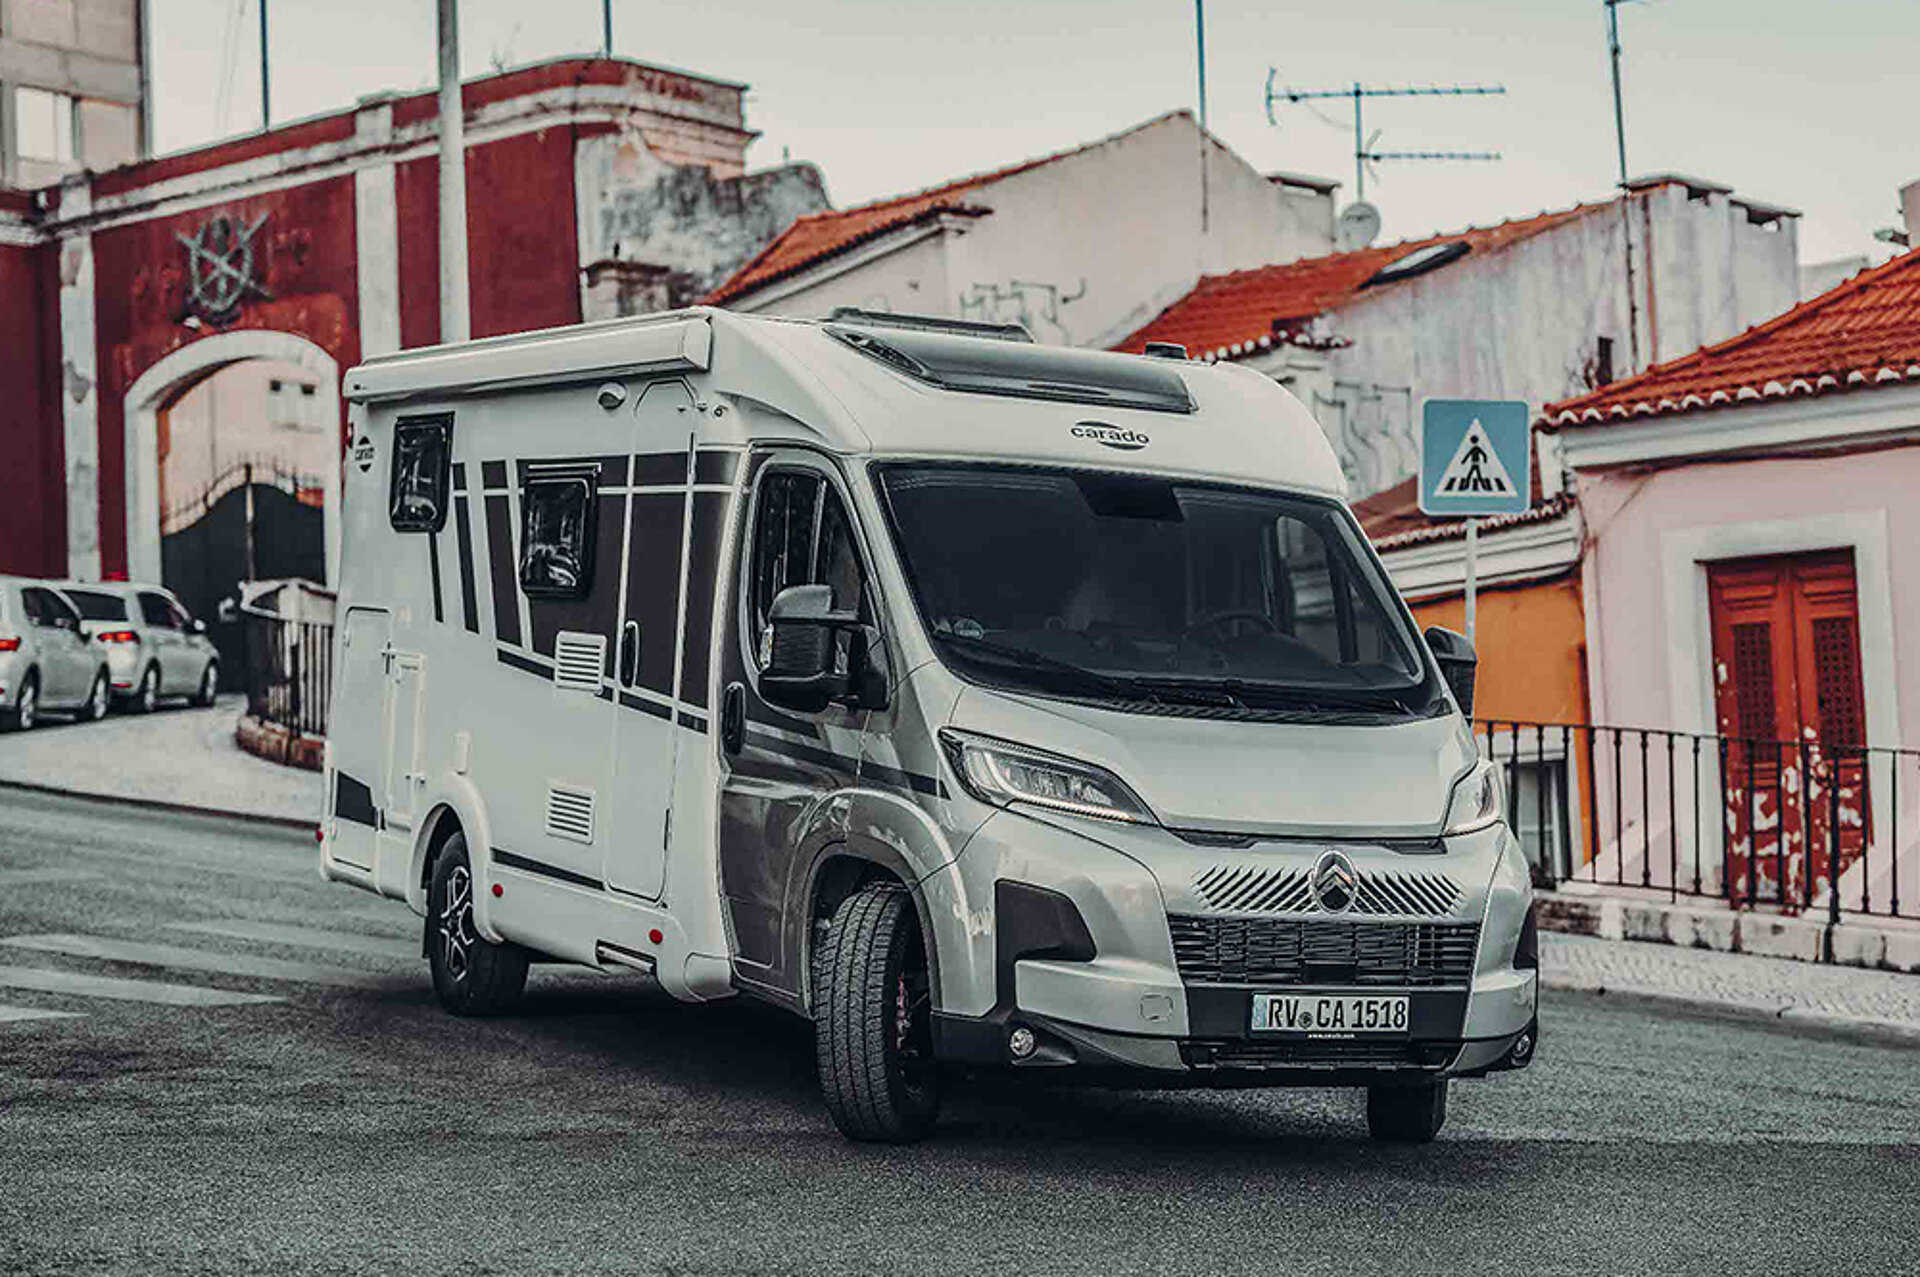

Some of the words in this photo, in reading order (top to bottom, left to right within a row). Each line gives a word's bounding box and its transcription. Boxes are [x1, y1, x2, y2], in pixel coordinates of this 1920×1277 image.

[1071, 426, 1150, 444] carado
[1268, 998, 1300, 1028] RV
[1316, 999, 1346, 1028] CA
[1351, 1000, 1406, 1029] 1518
